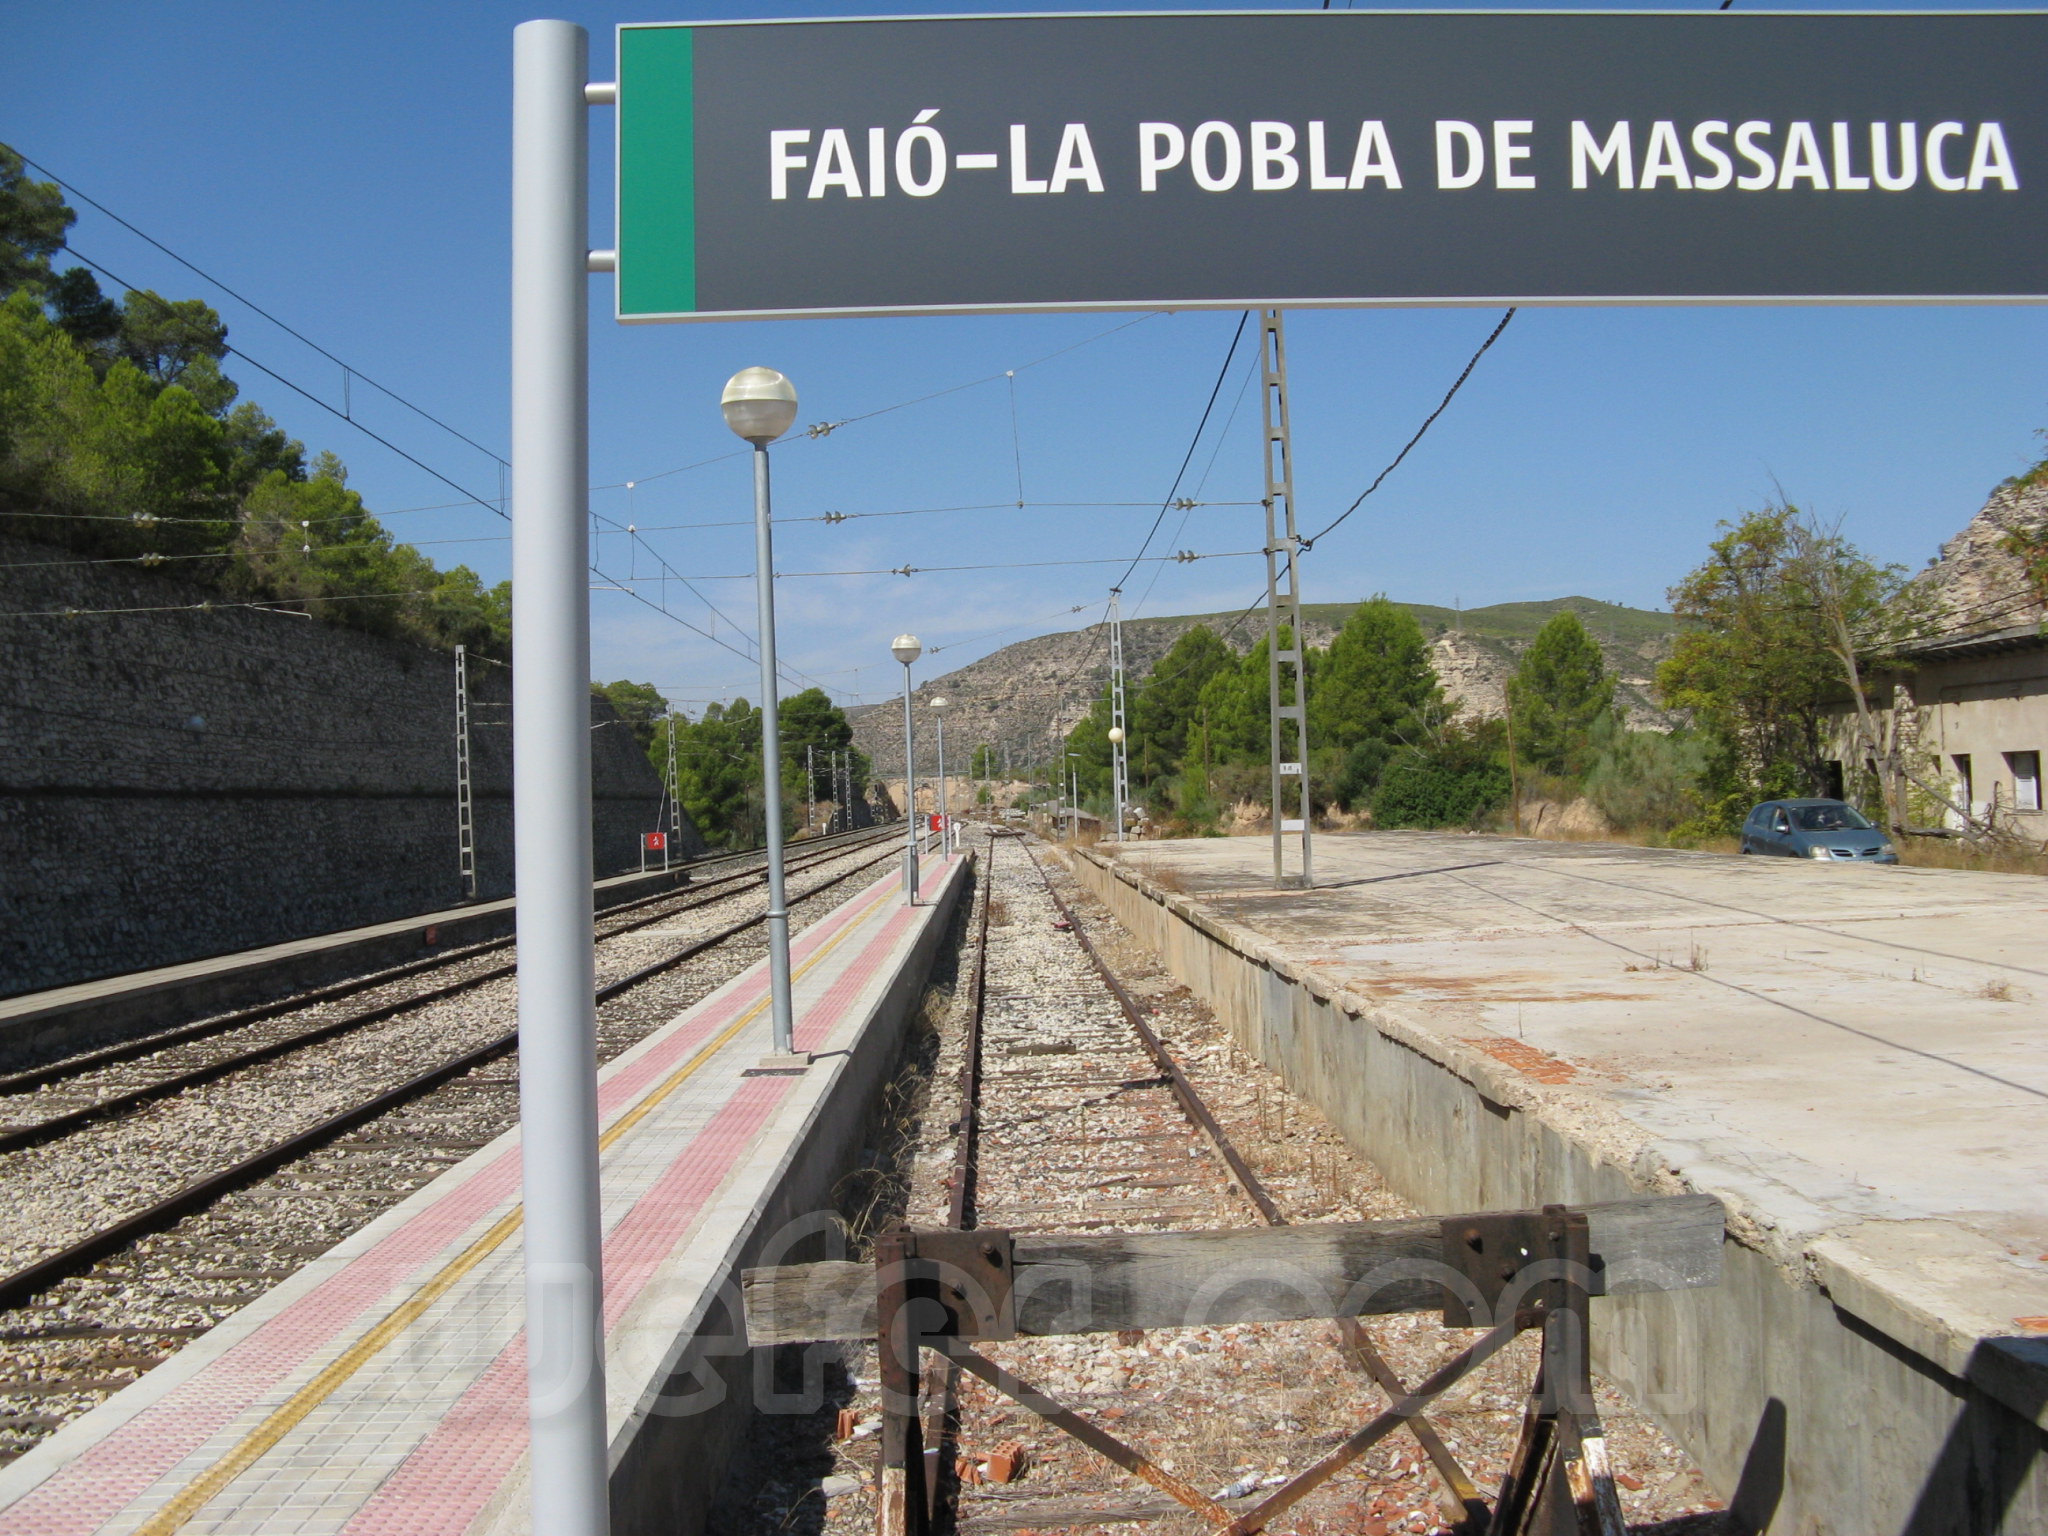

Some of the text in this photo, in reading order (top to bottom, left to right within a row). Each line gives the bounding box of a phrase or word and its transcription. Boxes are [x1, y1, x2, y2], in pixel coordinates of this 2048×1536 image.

[1139, 119, 1402, 192] POBLA
[1435, 119, 1537, 189] DE
[1571, 119, 2019, 192] MASSALUCA
